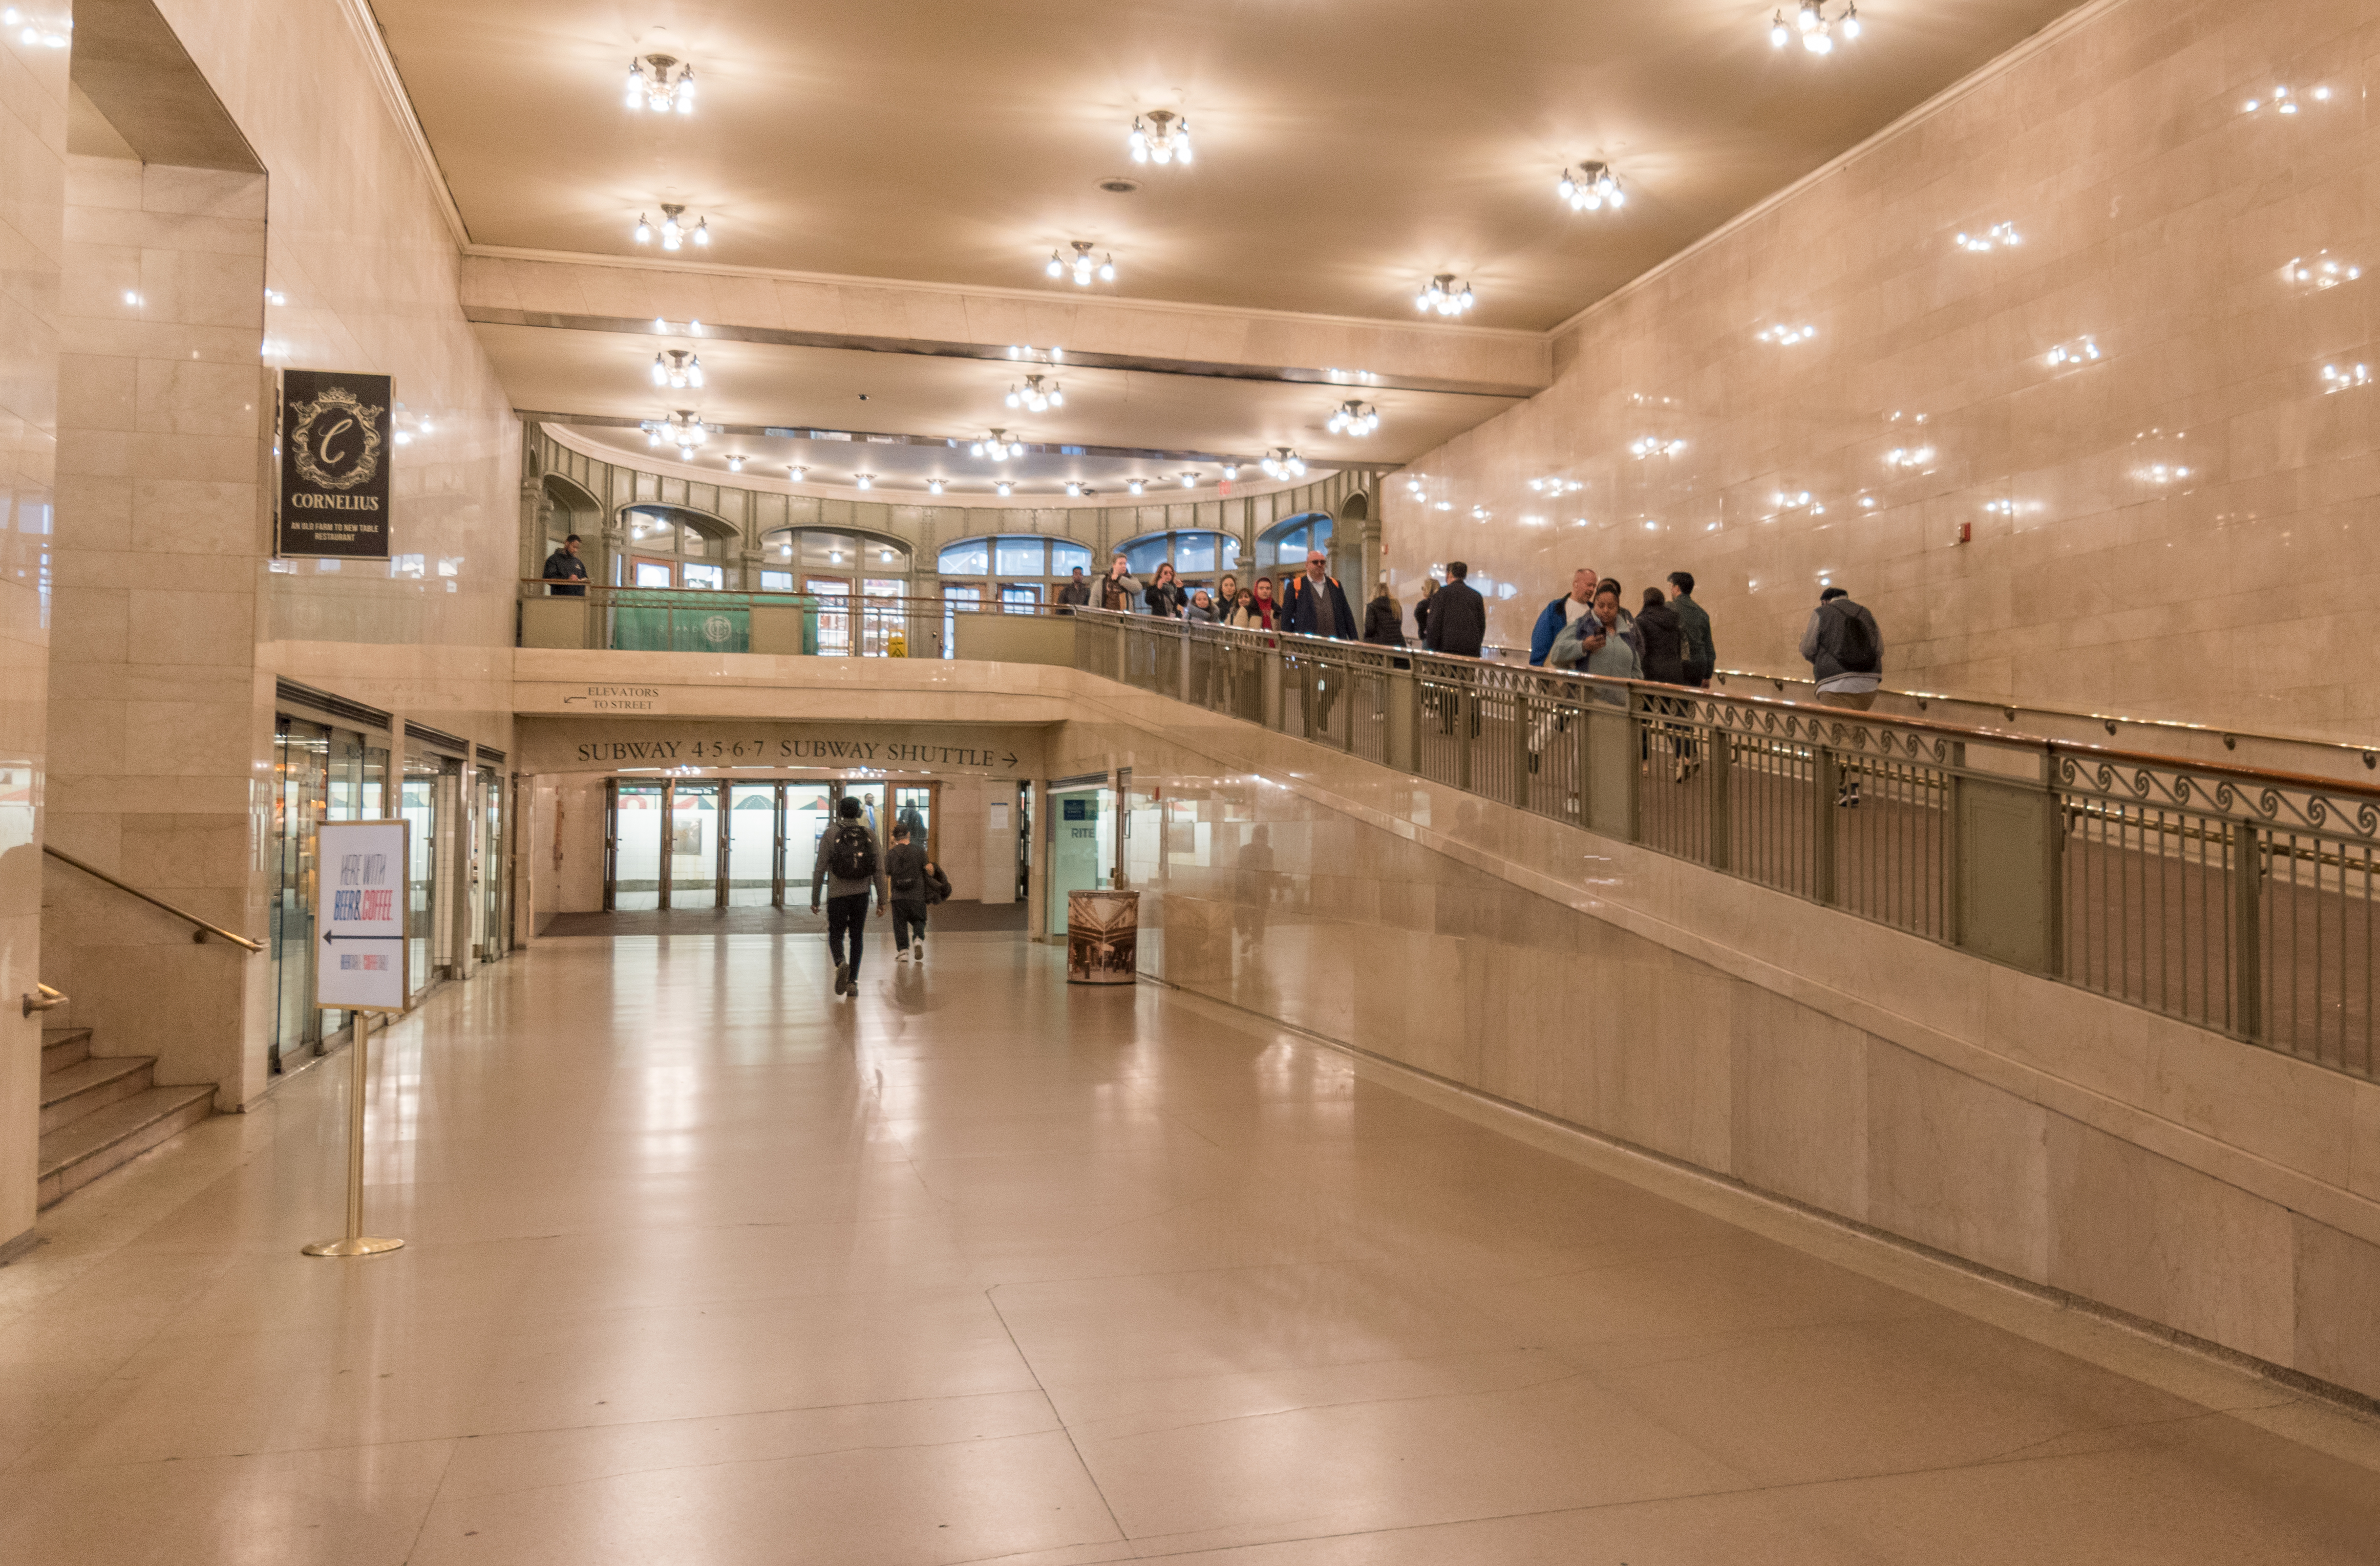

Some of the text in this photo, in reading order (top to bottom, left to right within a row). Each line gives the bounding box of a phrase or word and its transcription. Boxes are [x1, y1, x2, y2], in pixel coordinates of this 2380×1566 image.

[292, 494, 379, 511] CORNELIUS
[315, 523, 333, 531] FARM
[334, 523, 343, 531] TO
[343, 524, 358, 532] NEW
[359, 524, 379, 532] TABLE
[314, 532, 355, 541] RESTAURANT
[588, 687, 659, 697] ELEVATORS
[593, 700, 653, 710] TO STREET
[578, 741, 682, 761] SUBWAY
[780, 739, 879, 760] SUBWAY
[887, 743, 995, 766] SHUTTLE
[1072, 828, 1095, 839] RITE
[362, 889, 393, 921] COFFEE
